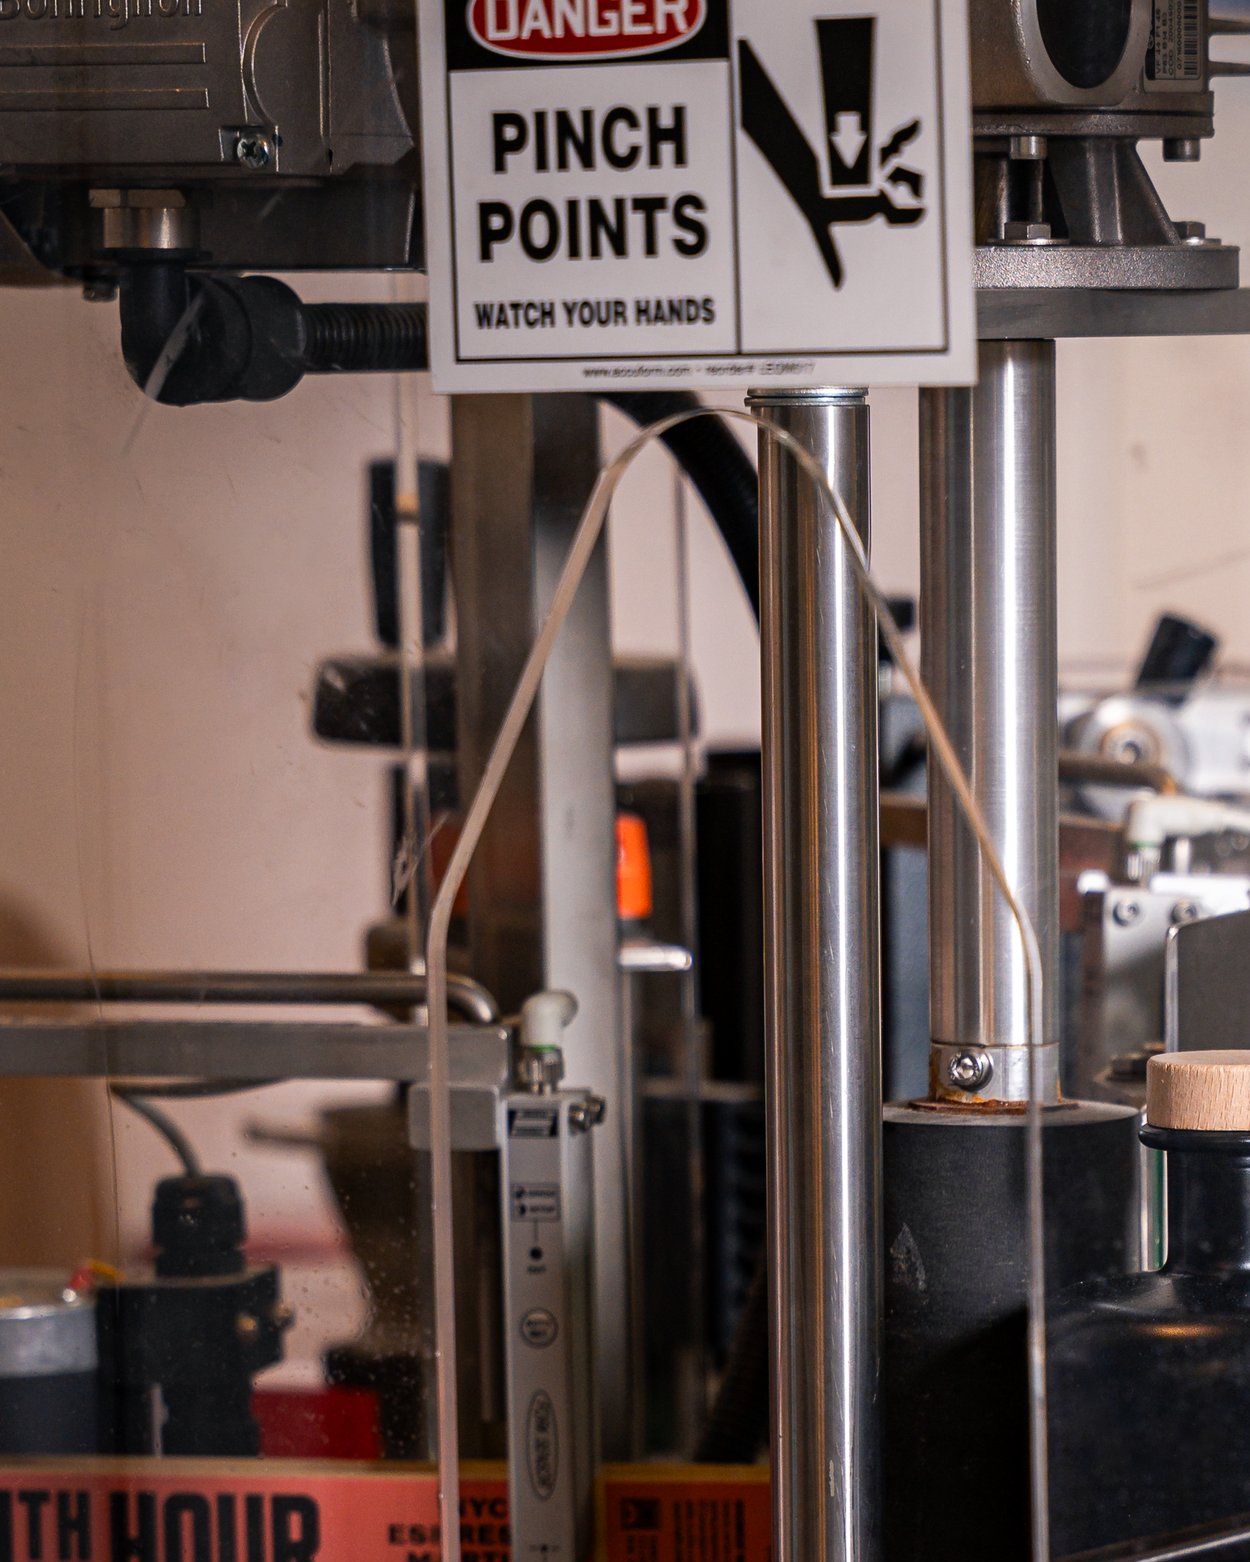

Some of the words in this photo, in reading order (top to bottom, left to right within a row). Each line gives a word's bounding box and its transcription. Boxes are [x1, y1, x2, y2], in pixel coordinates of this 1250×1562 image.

[484, 0, 690, 41] DANGER
[492, 105, 689, 174] PINCH
[477, 192, 710, 263] POINTS
[474, 301, 556, 330] WATCH
[562, 299, 628, 328] YOUR
[635, 296, 716, 326] HANDS
